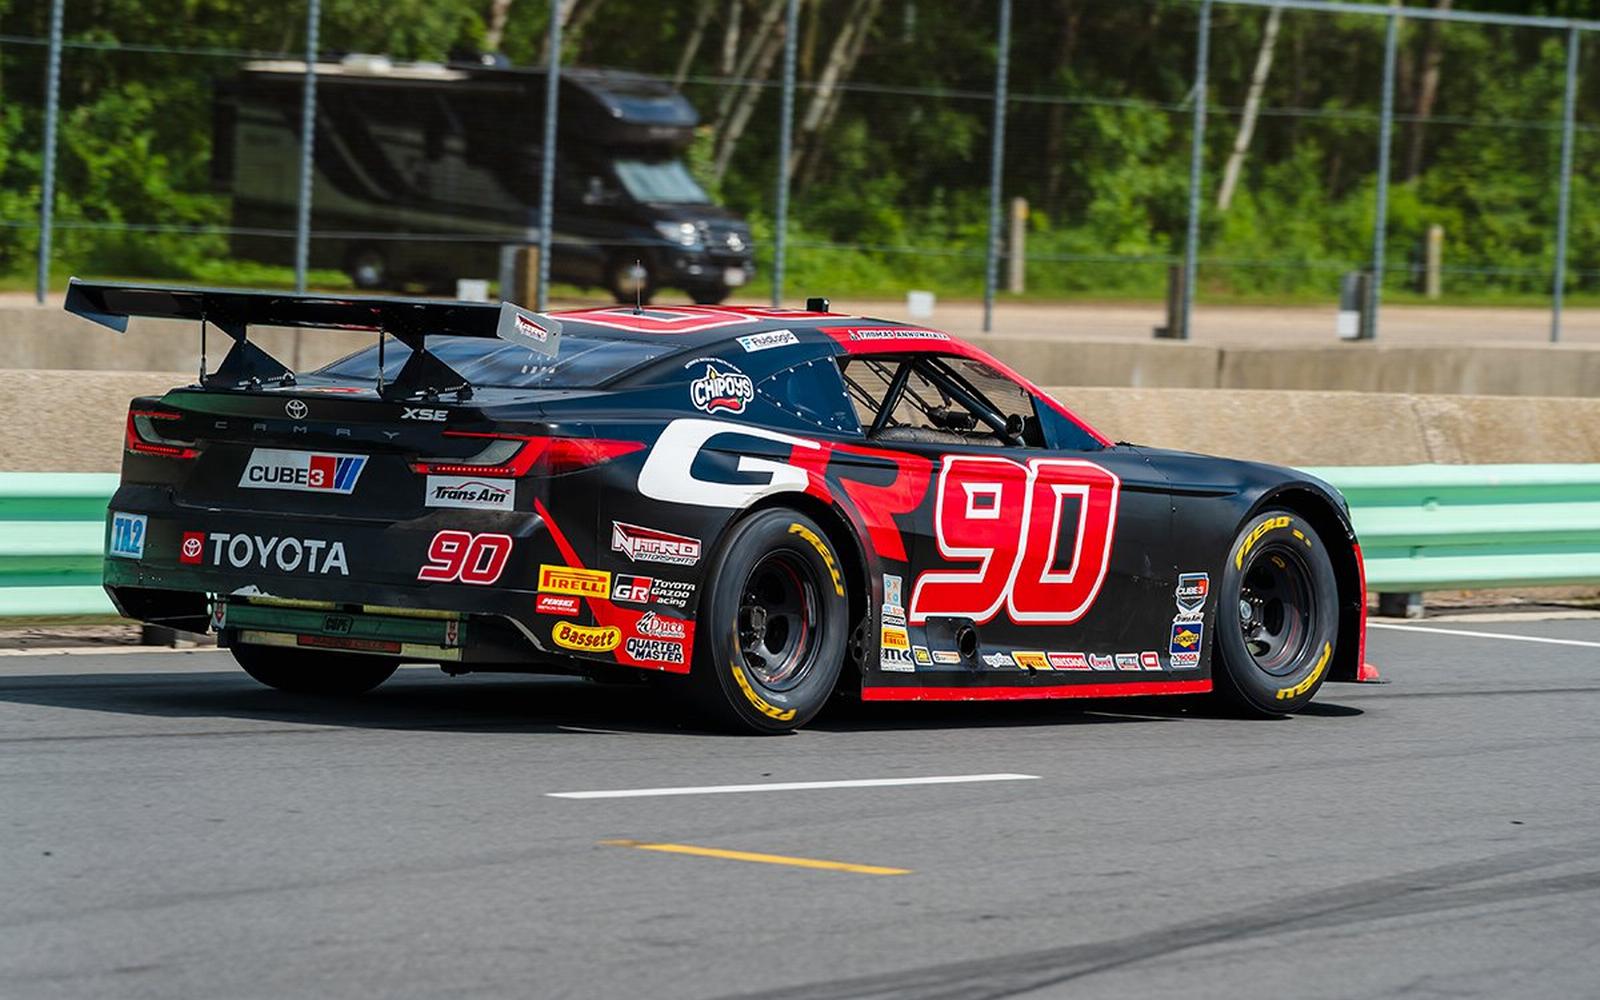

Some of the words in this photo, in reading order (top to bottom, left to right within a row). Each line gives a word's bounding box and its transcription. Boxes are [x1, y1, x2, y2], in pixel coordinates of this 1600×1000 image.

[860, 331, 893, 340] THOMAS
[694, 376, 751, 406] CHIPOYS
[401, 407, 448, 422] XSE
[248, 465, 324, 487] CUBE3
[435, 486, 477, 501] Trans
[477, 489, 506, 502] Am
[114, 517, 143, 555] TA2
[909, 454, 1120, 625] 90
[209, 532, 350, 576] TOYOTA
[416, 529, 513, 586] 90
[543, 569, 607, 593] PIRELLI
[654, 579, 696, 591] TOYOTA
[614, 584, 649, 601] GR
[651, 587, 690, 598] GAZOO
[559, 626, 615, 647] Bassett
[626, 638, 682, 653] QUARTER
[634, 648, 683, 662] MASTER
